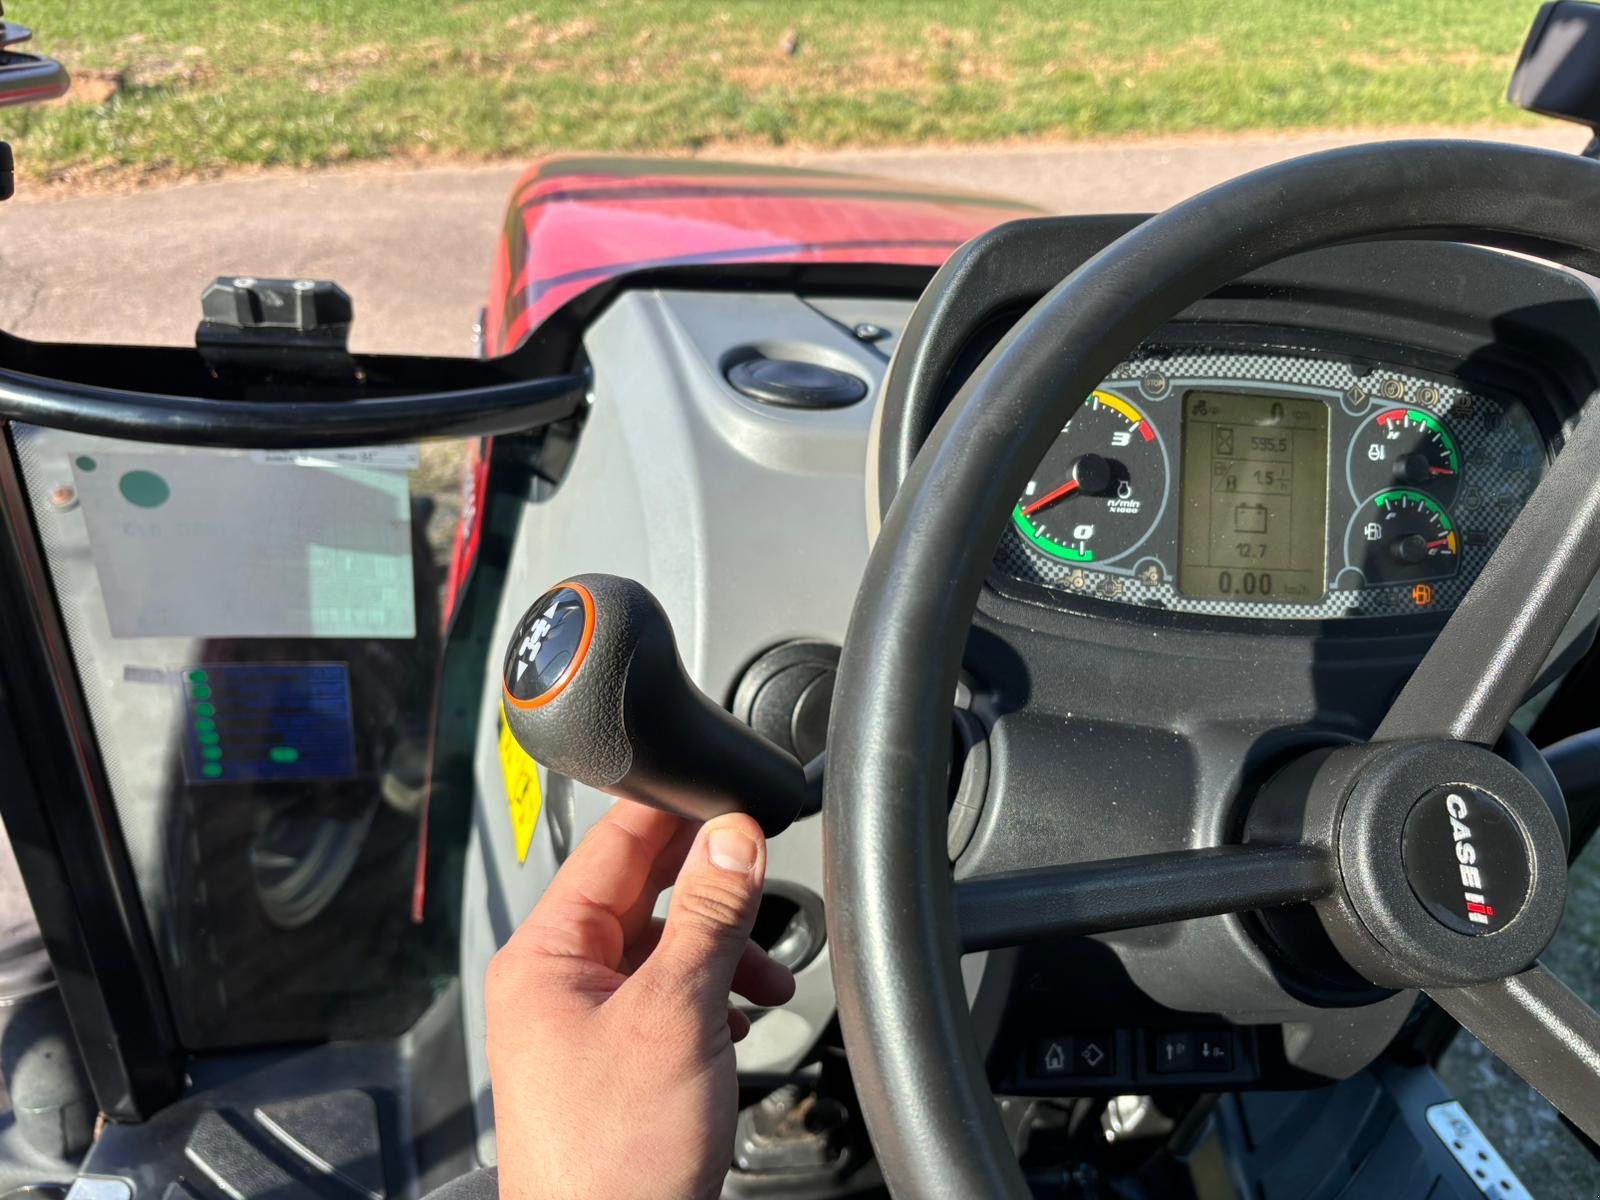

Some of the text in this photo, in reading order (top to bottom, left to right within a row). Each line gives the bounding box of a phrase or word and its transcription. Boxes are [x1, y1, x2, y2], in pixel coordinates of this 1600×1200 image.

[1111, 432, 1131, 446] 3
[1254, 469, 1274, 486] 1.5
[1025, 481, 1037, 496] 1
[1107, 499, 1140, 508] n/min
[1073, 524, 1095, 540] 0
[1236, 543, 1267, 559] 12.7
[1218, 570, 1272, 596] 0.00
[1446, 793, 1482, 890] CASE
